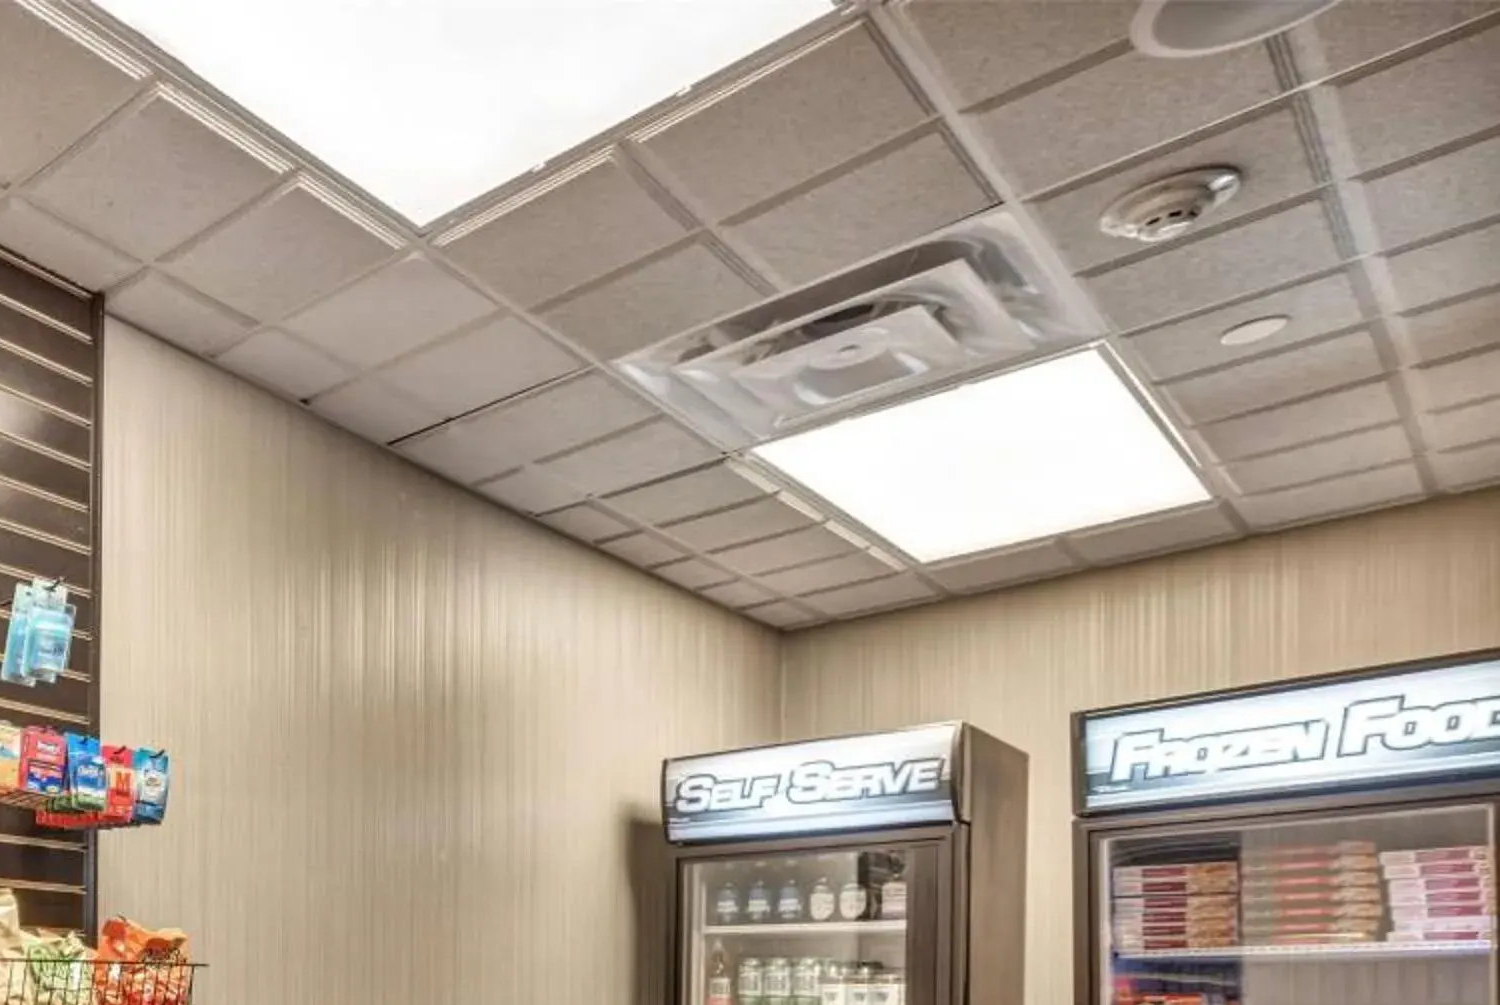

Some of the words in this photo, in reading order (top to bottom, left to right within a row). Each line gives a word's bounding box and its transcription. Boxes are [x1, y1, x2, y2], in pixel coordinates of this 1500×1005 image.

[1110, 719, 1329, 783] FROZEN
[675, 773, 781, 814] SELF
[786, 757, 945, 804] SERVE
